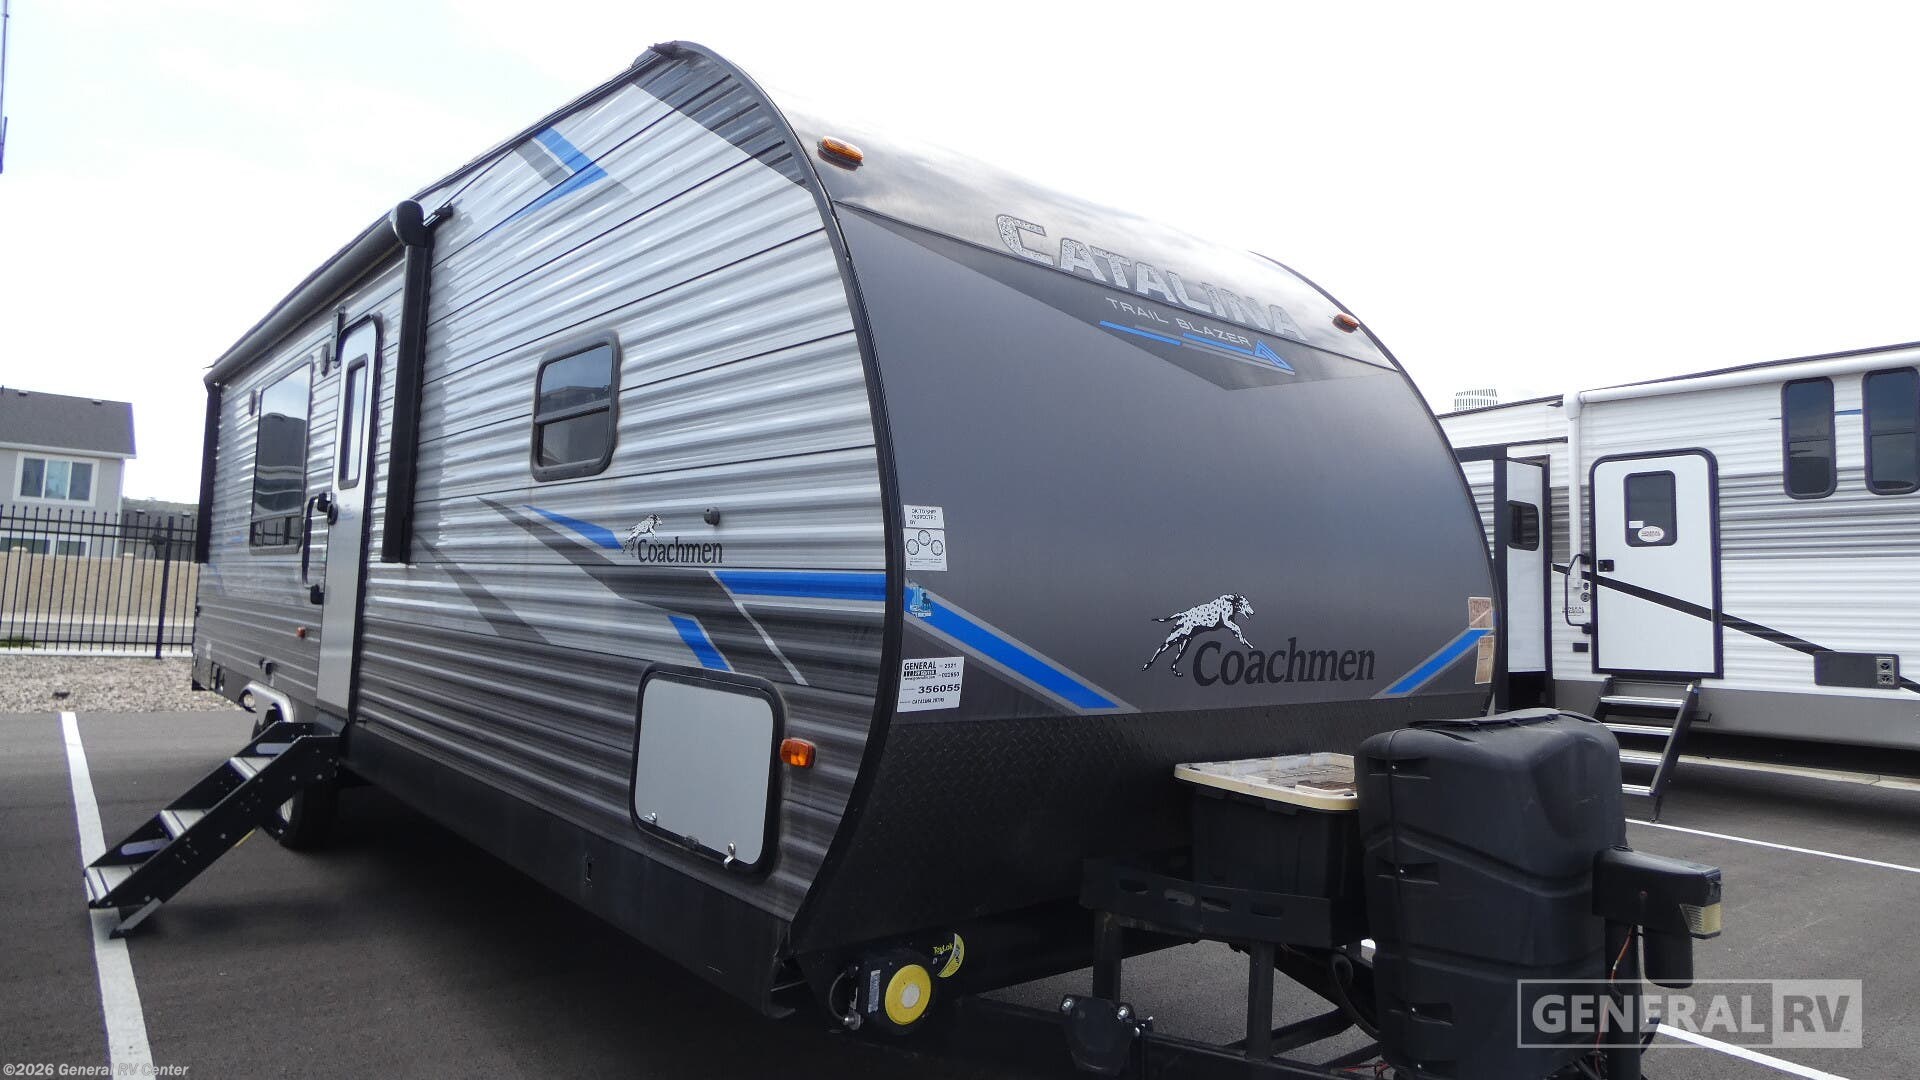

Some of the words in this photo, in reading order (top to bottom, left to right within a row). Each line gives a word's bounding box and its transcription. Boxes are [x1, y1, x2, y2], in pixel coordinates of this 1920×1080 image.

[996, 213, 1308, 341] CATALINA
[1105, 296, 1168, 325] TRAIL
[1176, 317, 1252, 347] BLAZER
[637, 536, 723, 564] Coachmen
[904, 661, 936, 670] GENERAL
[1192, 637, 1376, 687] Coachmen
[918, 683, 960, 693] 356055
